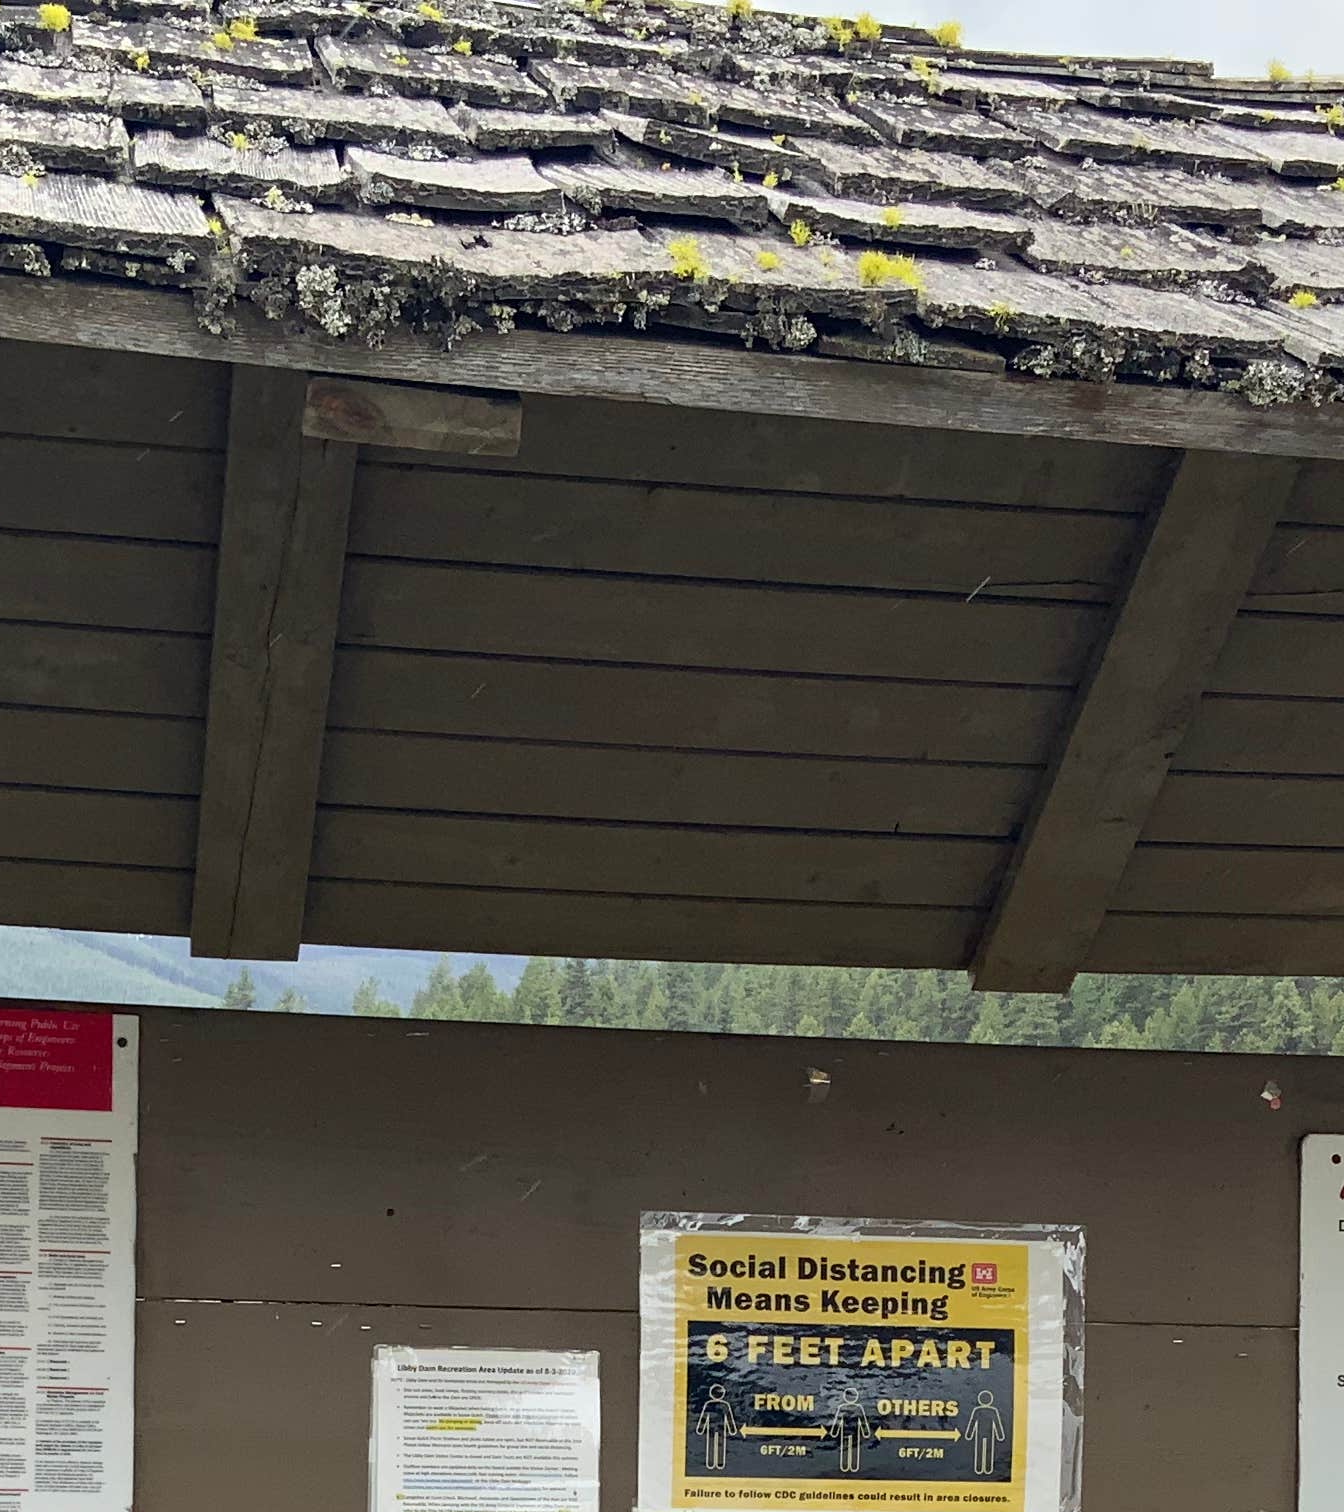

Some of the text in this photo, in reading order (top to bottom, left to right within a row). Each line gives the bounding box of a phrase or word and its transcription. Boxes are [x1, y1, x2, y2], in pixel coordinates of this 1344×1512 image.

[687, 1253, 966, 1290] Social Distancing
[707, 1286, 949, 1321] Means Keeping
[706, 1334, 996, 1369] 6 FEET APART
[753, 1393, 959, 1417] FROM OTHERS
[760, 1444, 806, 1456] 6FT/2M
[898, 1447, 943, 1459] 6FT/2M
[684, 1488, 721, 1497] Failure
[724, 1489, 735, 1498] to
[738, 1489, 771, 1498] follow
[774, 1490, 796, 1499] CDC
[798, 1491, 854, 1501] guidelines
[857, 1492, 886, 1500] could
[889, 1493, 920, 1501] result
[923, 1492, 933, 1501] in
